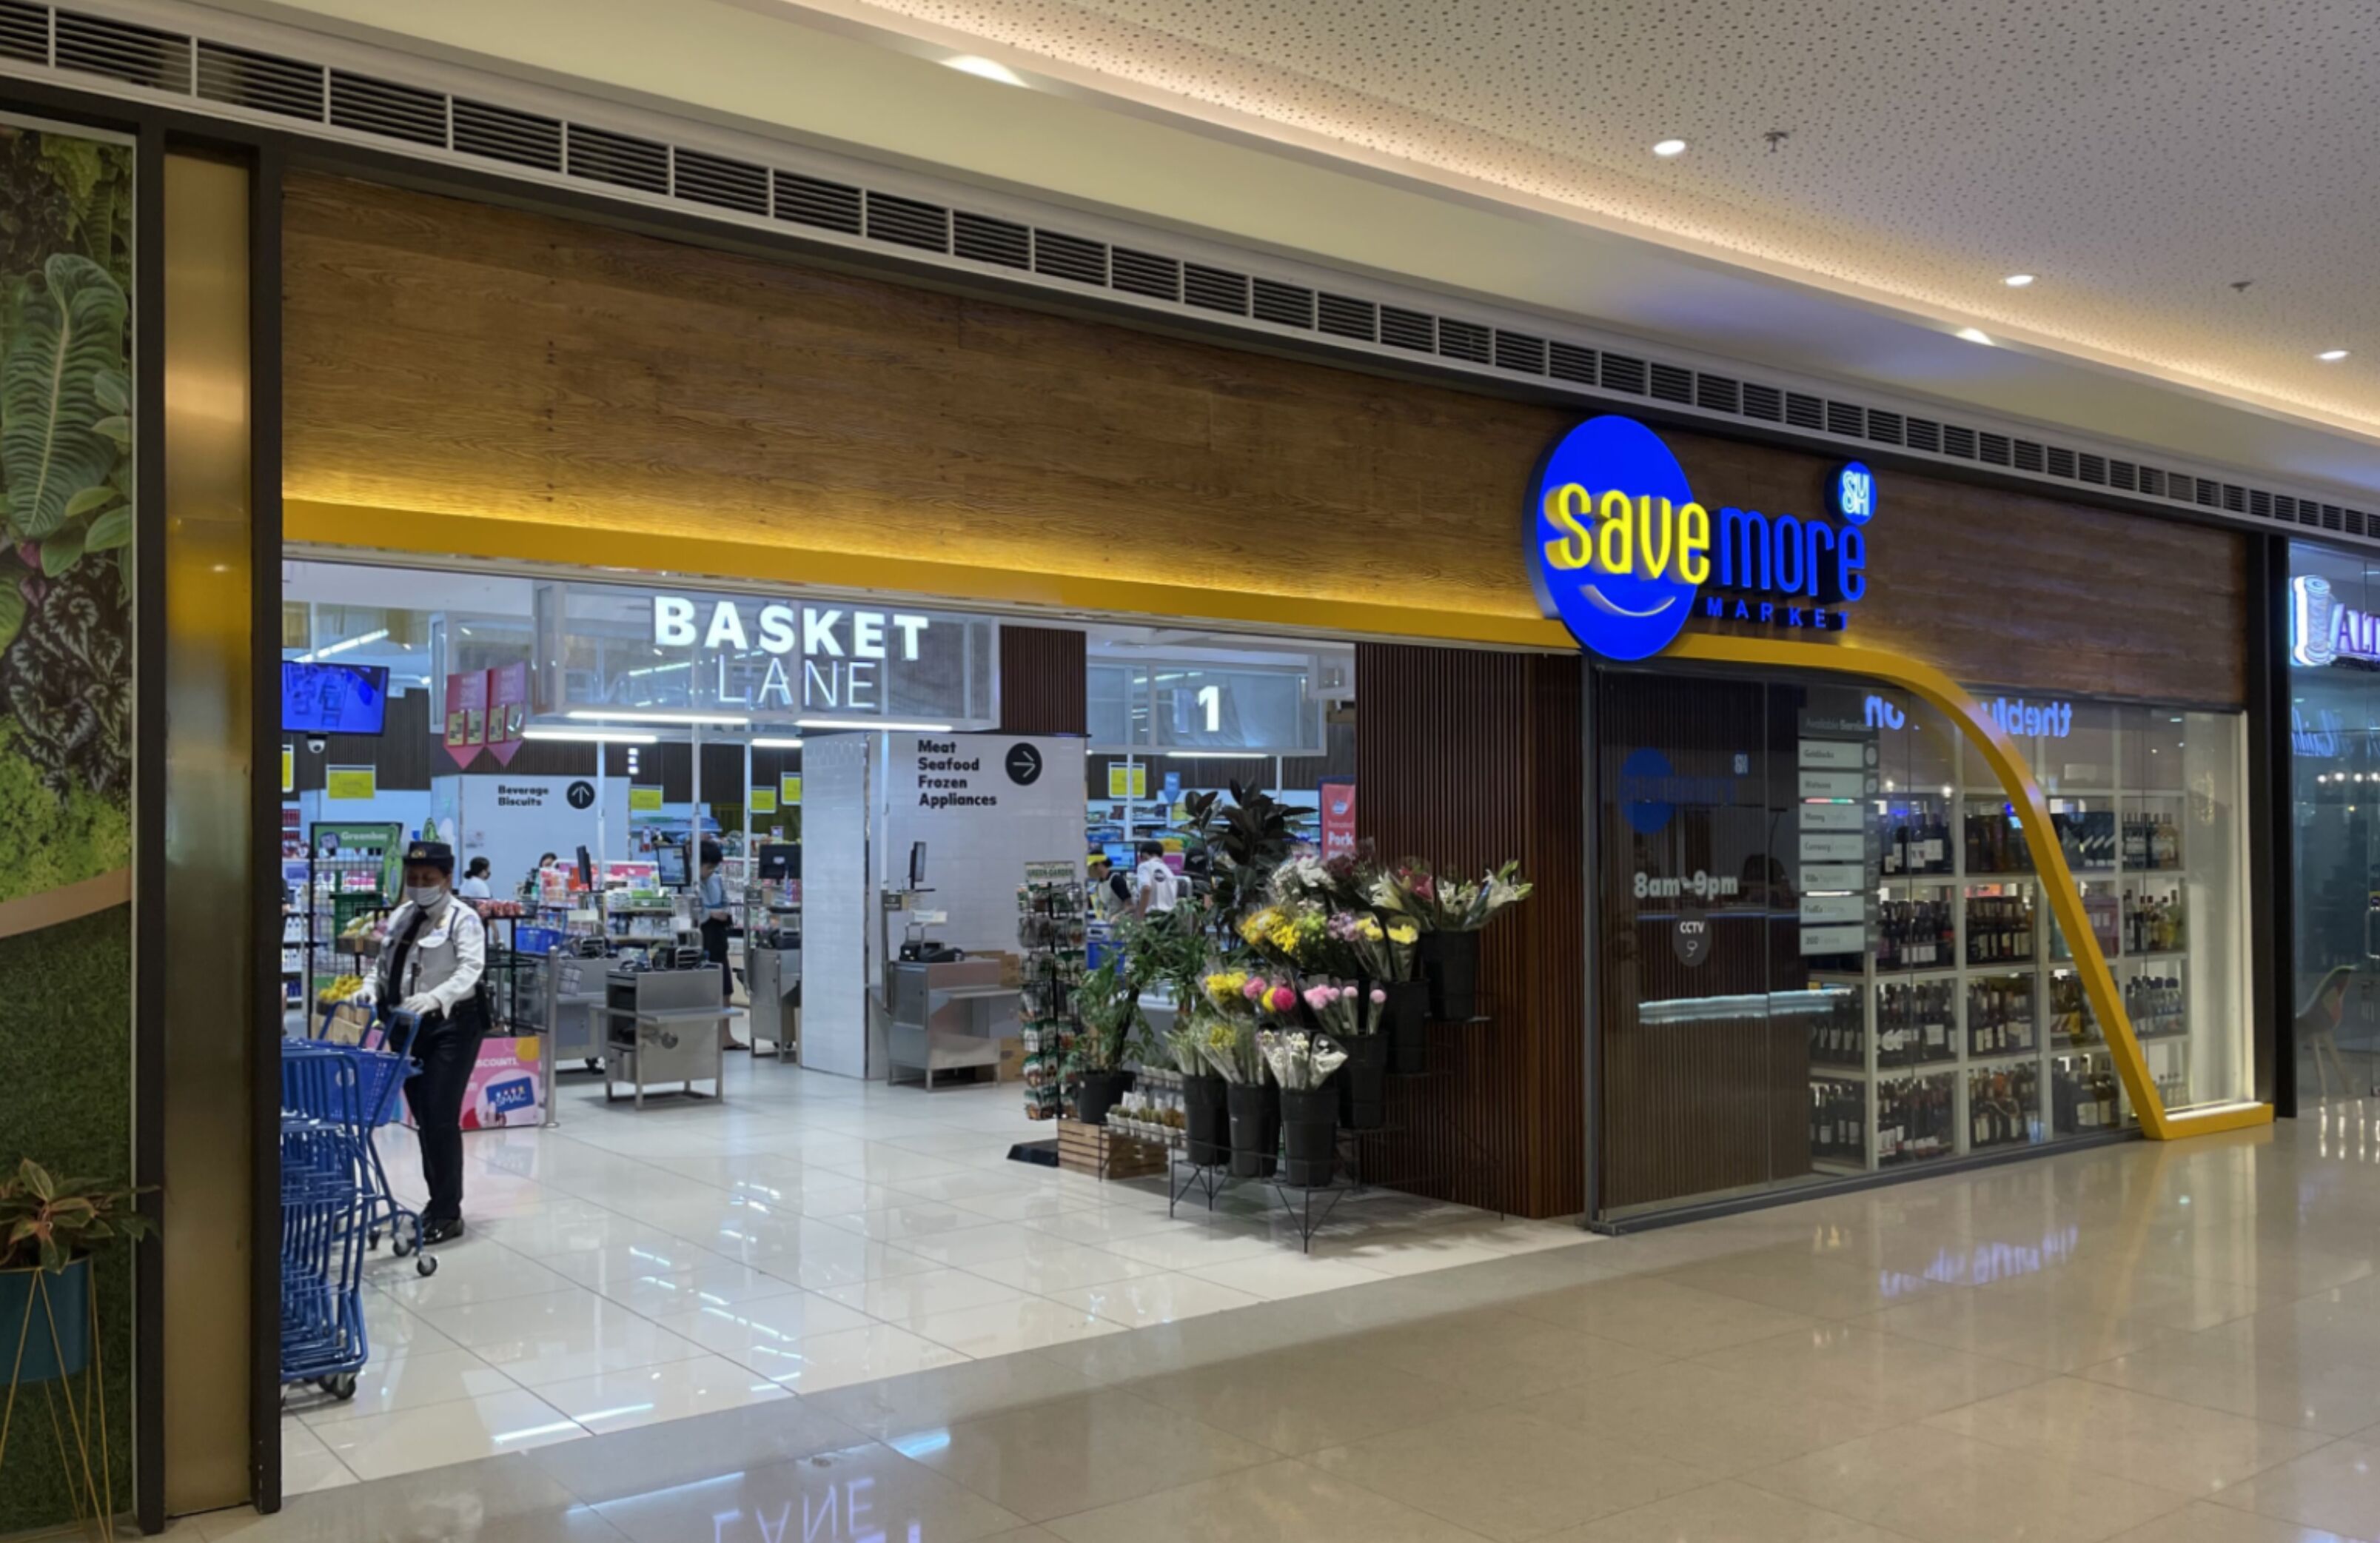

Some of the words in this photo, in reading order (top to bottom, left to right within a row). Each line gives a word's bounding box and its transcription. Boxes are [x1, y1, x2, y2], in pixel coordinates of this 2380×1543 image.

[1706, 596, 1849, 632] MARKET
[651, 595, 929, 661] BASKET
[717, 655, 876, 709] LANE
[1197, 685, 1220, 732] 1
[918, 740, 956, 753] Meat
[918, 757, 980, 771] Seafood
[918, 774, 968, 789] Frozen
[497, 785, 549, 796] Beverage
[497, 796, 542, 806] Biscuits
[919, 792, 998, 809] Appliances
[1680, 921, 1705, 934] CCTV
